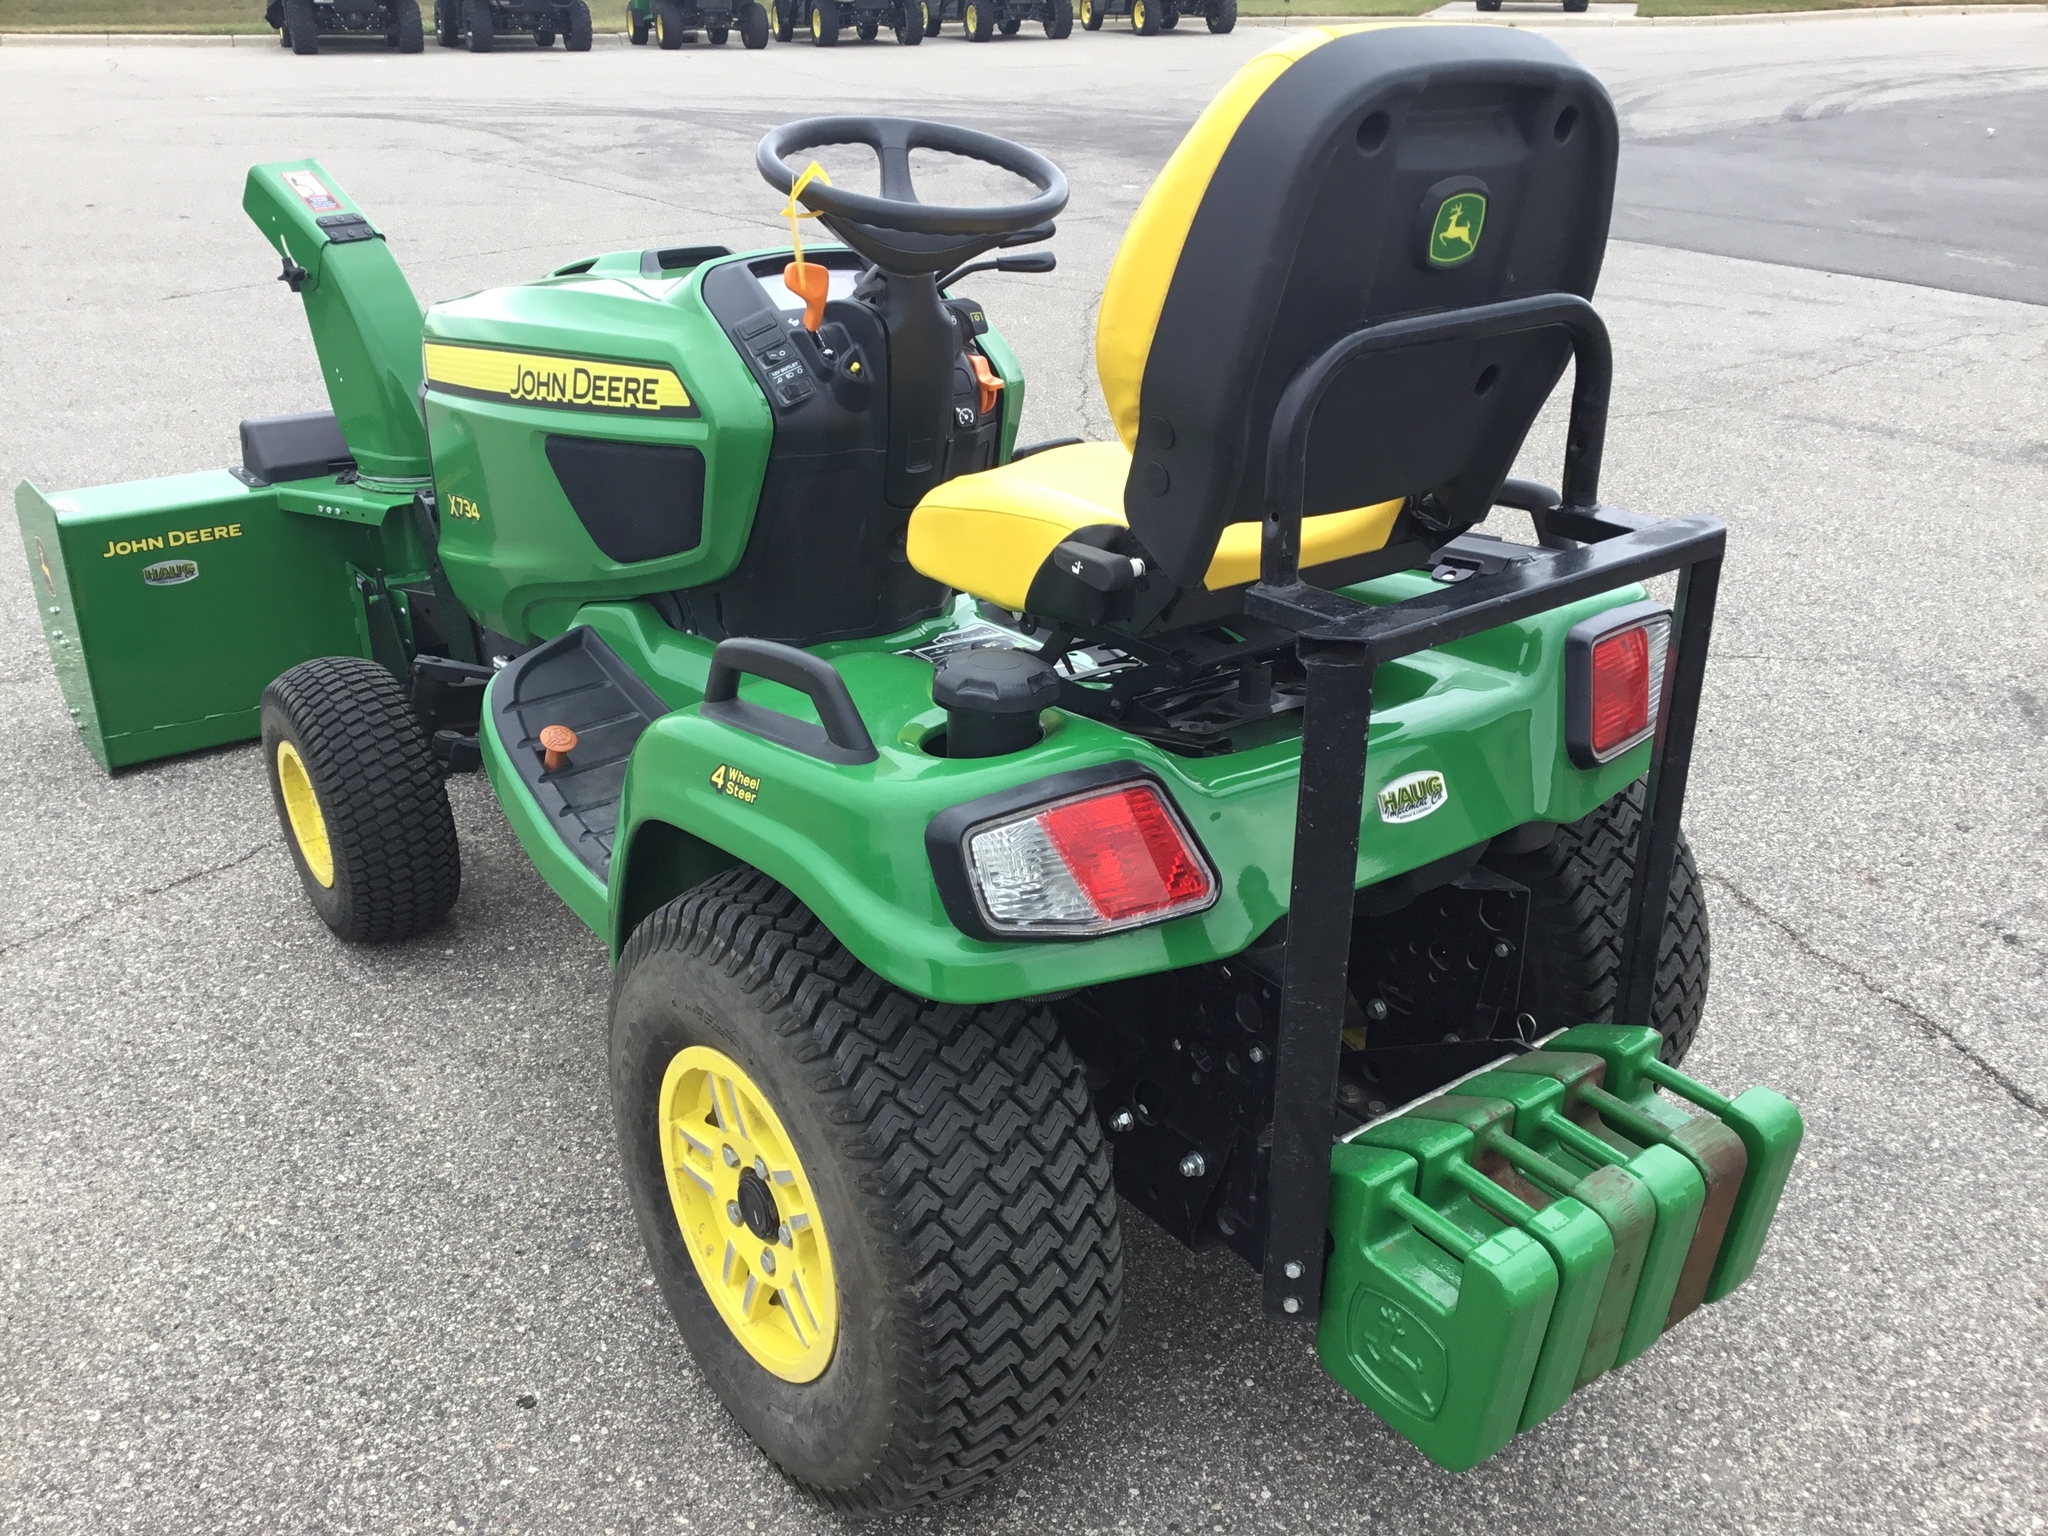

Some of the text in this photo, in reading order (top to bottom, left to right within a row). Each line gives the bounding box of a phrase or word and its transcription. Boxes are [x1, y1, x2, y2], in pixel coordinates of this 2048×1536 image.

[780, 361, 799, 373] OUTLET
[510, 364, 660, 406] JOHN DEERE
[447, 493, 481, 521] X734
[103, 523, 243, 558] JOHN DEERE
[144, 563, 196, 580] HAUG
[711, 764, 760, 791] 4 Wheel
[726, 781, 757, 804] Steer
[1378, 776, 1443, 813] HAUG
